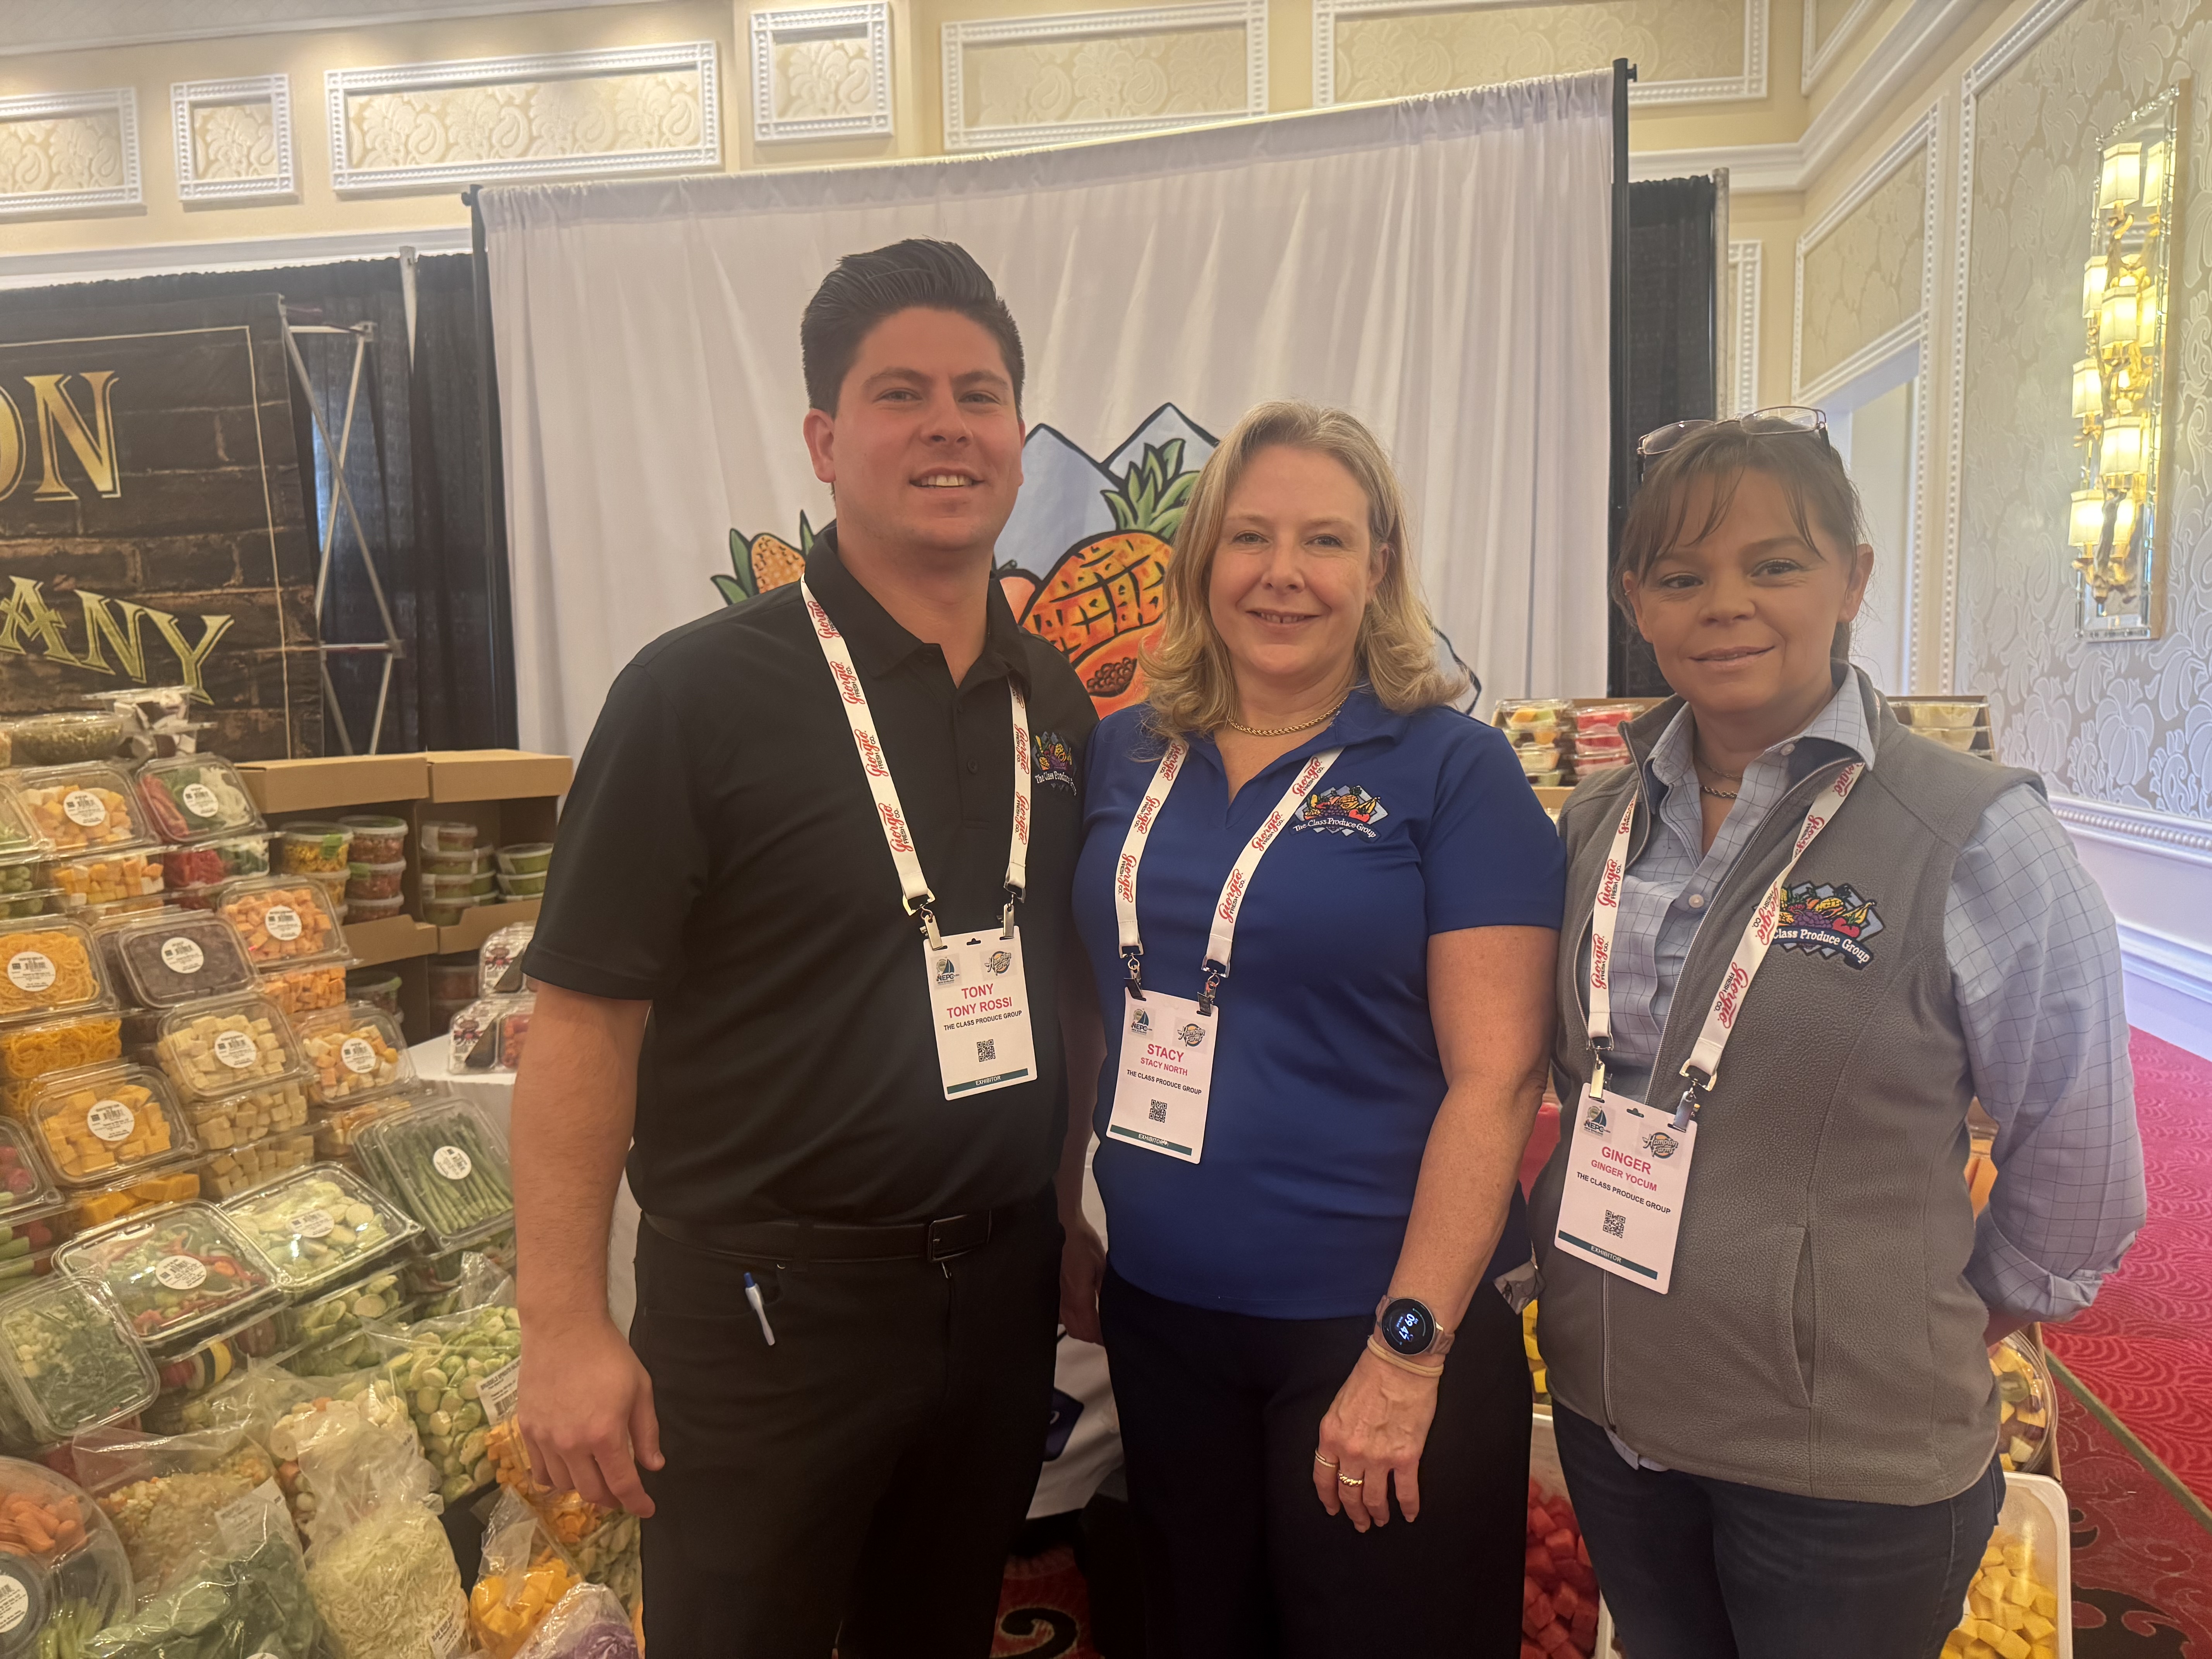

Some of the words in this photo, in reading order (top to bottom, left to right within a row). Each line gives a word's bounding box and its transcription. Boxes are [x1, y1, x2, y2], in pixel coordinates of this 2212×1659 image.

[0, 371, 121, 502] N
[830, 661, 866, 704] Giorgio
[852, 682, 861, 697] FRESH
[854, 729, 889, 776] Giorgio
[1014, 724, 1029, 774] Giorgio
[1166, 749, 1175, 761] FRESH
[875, 752, 884, 769] FRESH
[1163, 743, 1185, 781] Giorgio
[1034, 774, 1045, 783] The
[1292, 757, 1321, 797] Giorgio
[1303, 778, 1315, 791] FRESH
[1137, 796, 1160, 834] Giorgio
[1140, 802, 1149, 814] FRESH
[878, 803, 914, 852] Giorgio
[1015, 792, 1029, 845] Giorgio
[1293, 823, 1307, 831] The
[1326, 817, 1356, 828] Produce
[1356, 823, 1376, 838] Group
[899, 826, 909, 844] FRESH
[1252, 811, 1281, 851] Giorgio
[1262, 832, 1274, 845] FRESH
[1118, 854, 1137, 903] Giorgio
[1597, 859, 1621, 907] Giorgio
[1219, 869, 1242, 923] Giorgio
[1230, 896, 1238, 914] FRESH
[1763, 890, 1774, 910] FRESH
[1757, 881, 1779, 945] Giorgio
[1800, 929, 1840, 945] Produce
[1841, 939, 1870, 963] Group
[1590, 934, 1608, 989] Giorgio
[962, 984, 994, 999] TONY
[1722, 972, 1735, 993] FRESH
[1719, 962, 1748, 1029] Giorgio
[947, 1003, 976, 1018] TONY
[980, 997, 1012, 1012] ROSSI
[956, 1020, 974, 1028] CLASS
[975, 1014, 1002, 1024] PRODUCE
[1003, 1010, 1022, 1018] GROUP
[1131, 1023, 1147, 1031] NEPC
[1177, 1026, 1205, 1040] Hampton
[1185, 1035, 1203, 1047] Farms
[1147, 1044, 1184, 1062] STACY
[1140, 1057, 1163, 1069] STACY
[1164, 1064, 1188, 1076] NORTH
[975, 1075, 1001, 1085] EXHIBITOR
[1138, 1073, 1155, 1082] CLASS
[1156, 1078, 1181, 1089] PRODUCE
[1182, 1085, 1202, 1095] GROUP
[1584, 1120, 1604, 1132] NEPC
[1139, 1134, 1164, 1145] EXHIBITOR
[1642, 1133, 1678, 1149] Hampton
[1602, 1146, 1651, 1175] GINGER
[1652, 1145, 1676, 1157] Farms
[1591, 1160, 1623, 1178] GINGER
[1625, 1173, 1657, 1192] YOCUM
[1577, 1172, 1589, 1182] THE
[1590, 1178, 1611, 1191] CLASS
[1612, 1187, 1644, 1205] PRODUCE
[1646, 1200, 1671, 1214] GROUP
[1591, 1245, 1621, 1263] EXHIBITOR
[1404, 1313, 1415, 1326] 09
[1399, 1326, 1409, 1340] 47
